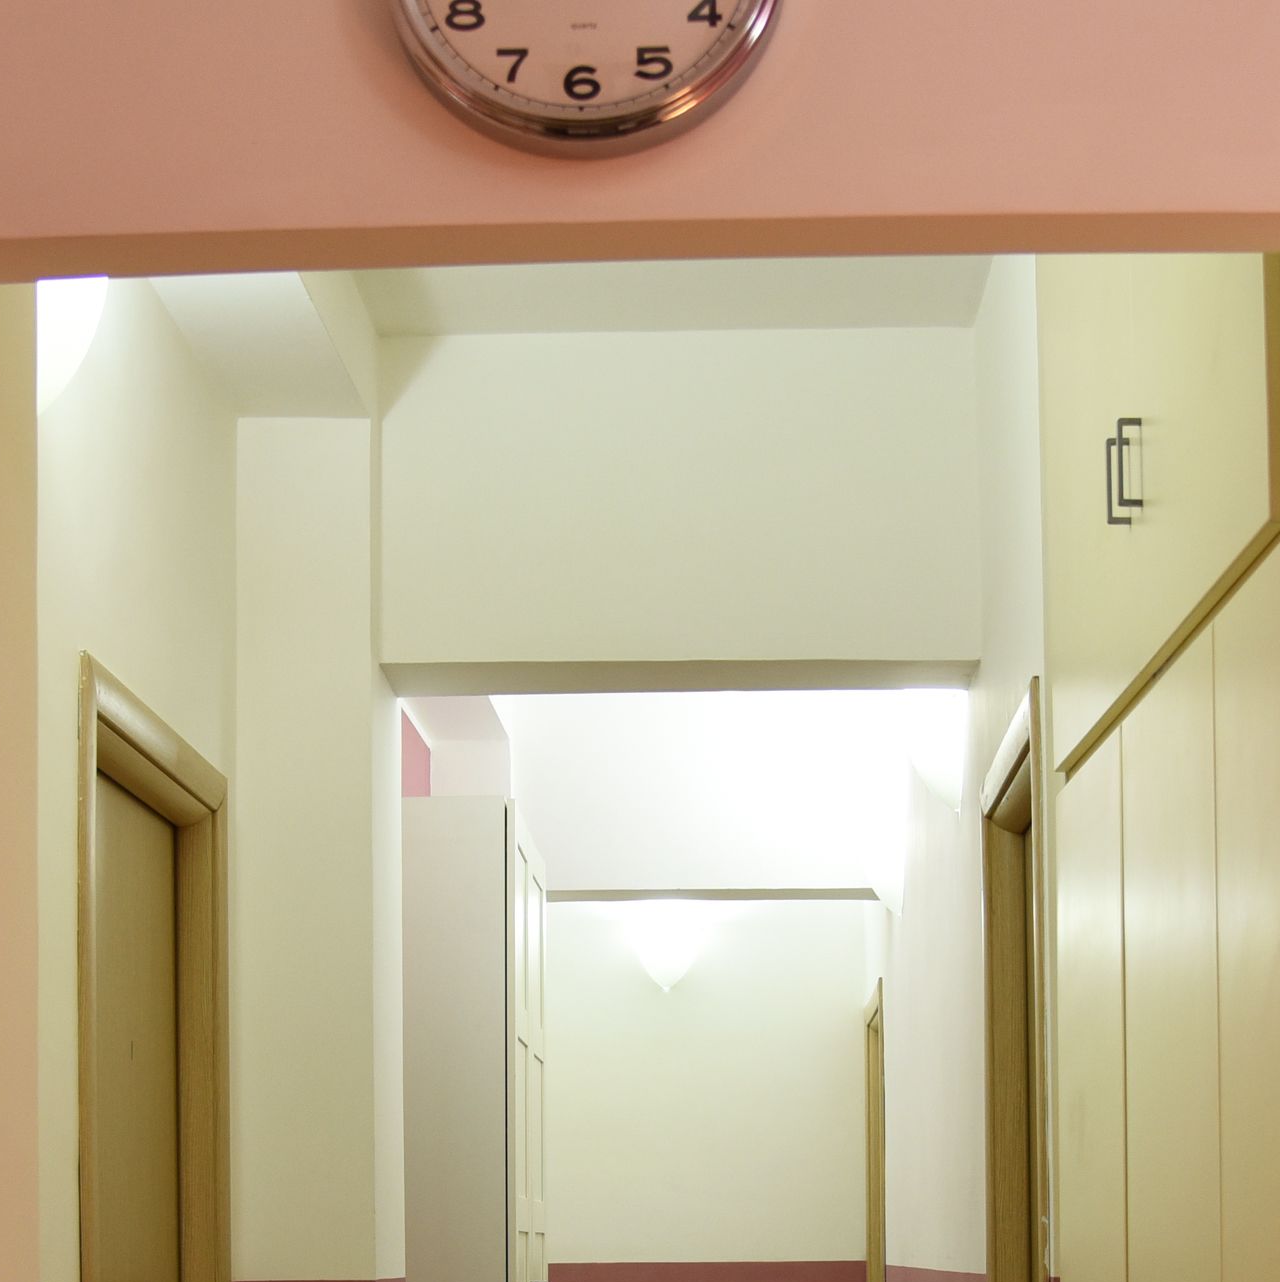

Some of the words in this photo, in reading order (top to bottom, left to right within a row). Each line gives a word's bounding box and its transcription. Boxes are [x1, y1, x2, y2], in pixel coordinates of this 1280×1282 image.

[445, 0, 485, 31] 8
[687, 0, 722, 27] 4
[496, 48, 528, 83] 7
[634, 46, 673, 80] 5
[563, 65, 601, 101] 6
